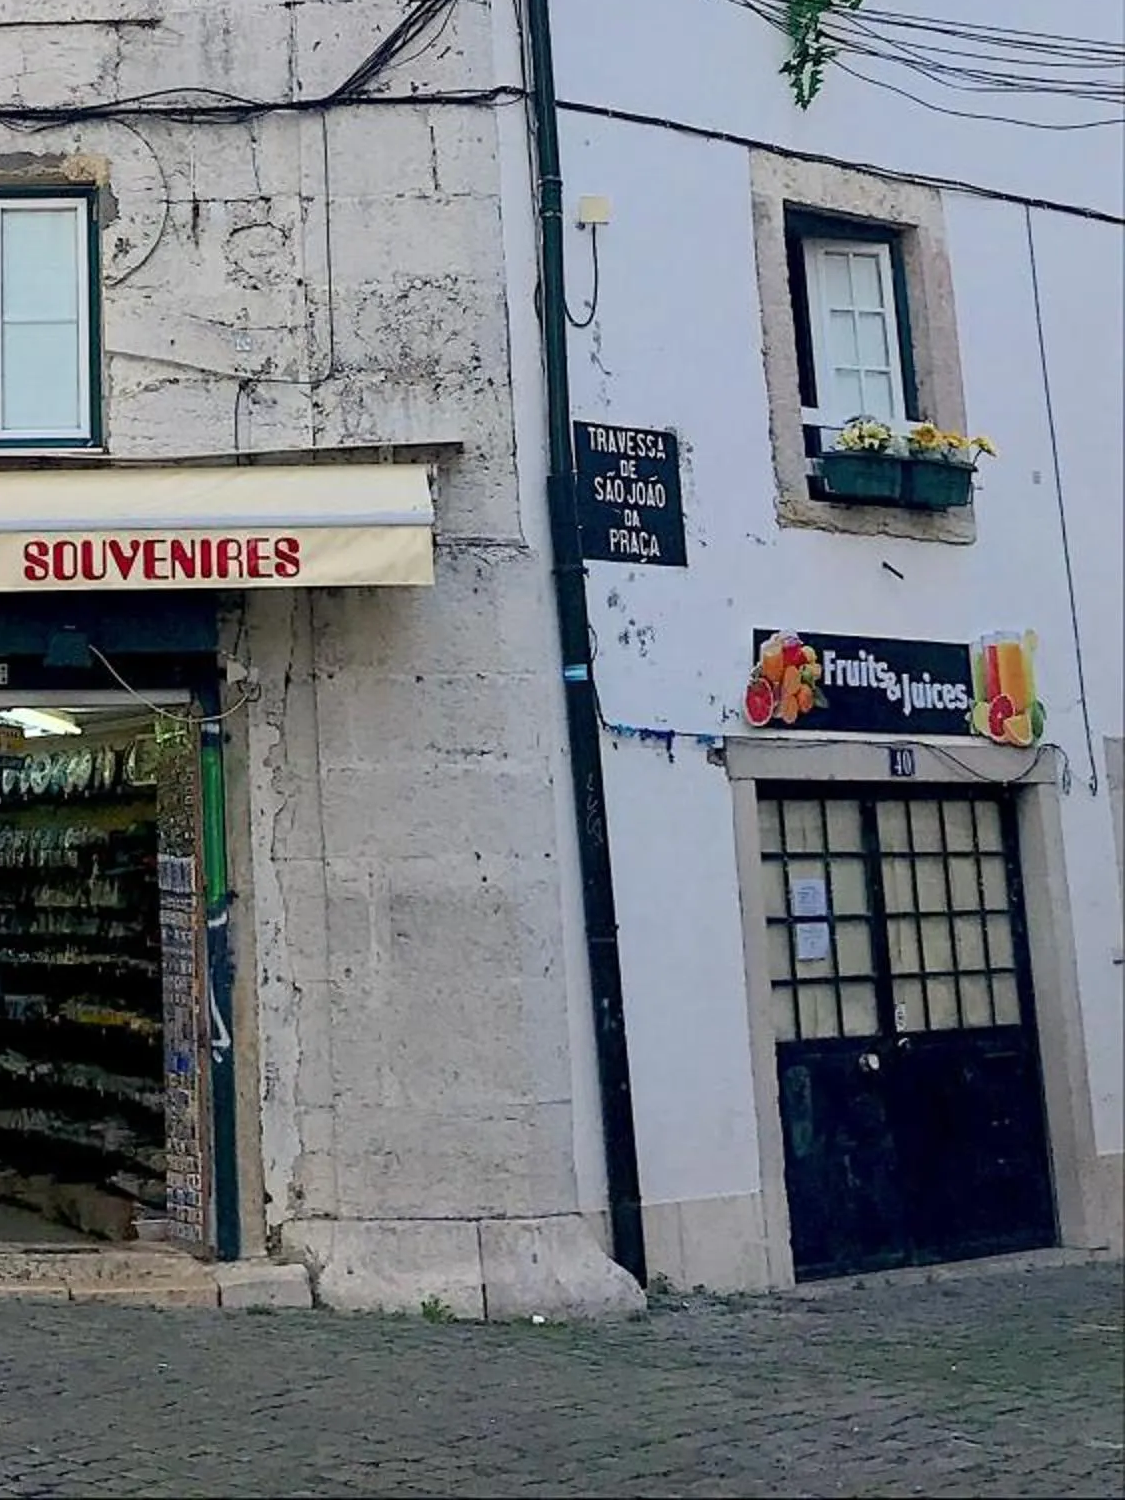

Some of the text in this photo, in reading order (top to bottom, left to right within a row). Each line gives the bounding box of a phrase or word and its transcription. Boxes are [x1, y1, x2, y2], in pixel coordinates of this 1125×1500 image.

[587, 427, 666, 460] TRAVESSA
[620, 459, 638, 479] DE
[594, 471, 666, 508] SÃO JOÃO
[624, 509, 641, 527] DA
[23, 536, 301, 583] SOUVENIRES
[609, 528, 661, 563] PRAÇA
[823, 650, 888, 690] Fruits
[902, 672, 968, 717] Juices
